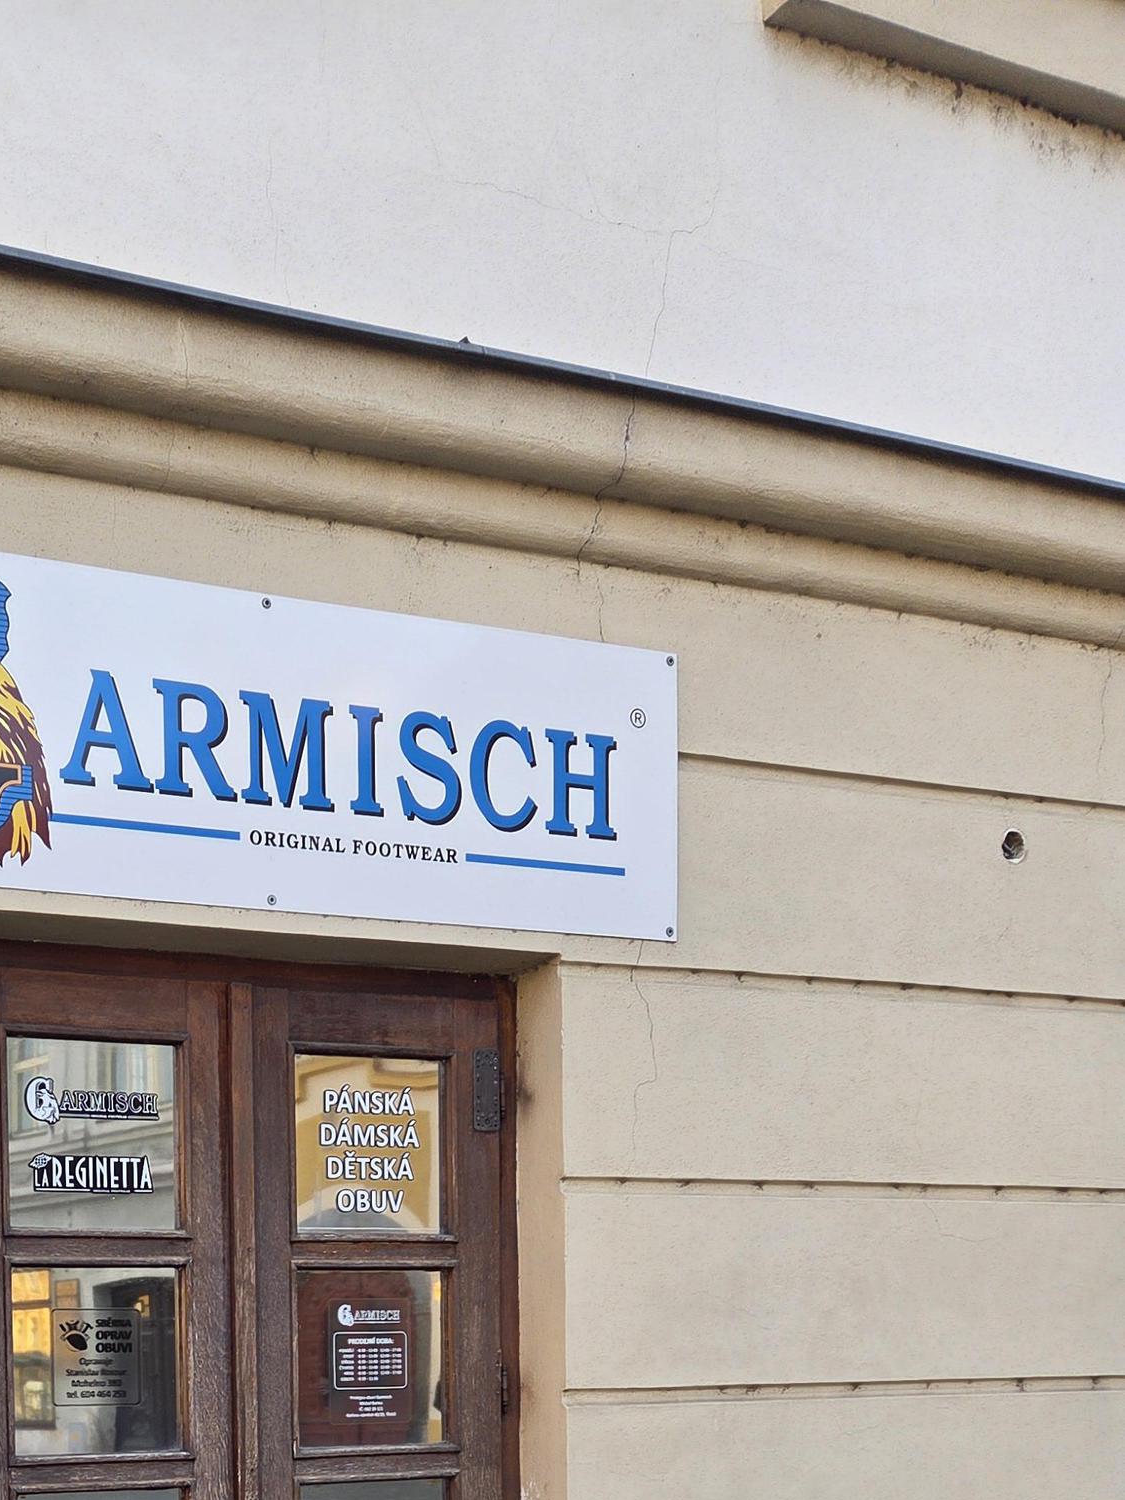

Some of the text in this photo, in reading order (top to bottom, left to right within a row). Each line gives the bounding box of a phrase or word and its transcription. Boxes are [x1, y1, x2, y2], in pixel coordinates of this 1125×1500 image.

[249, 829, 459, 864] ORIGINAL FOOTWEAR
[25, 1077, 158, 1124] GARMISCH
[324, 1086, 415, 1116] PÁNSKÁ
[320, 1119, 420, 1148] DÁMSKÁ
[35, 1156, 152, 1189] LA REGINETTA
[326, 1152, 414, 1180] DĚTSKÁ
[337, 1190, 404, 1213] OBUV
[95, 1330, 132, 1340] OPRAV
[95, 1343, 132, 1353] OBUVI
